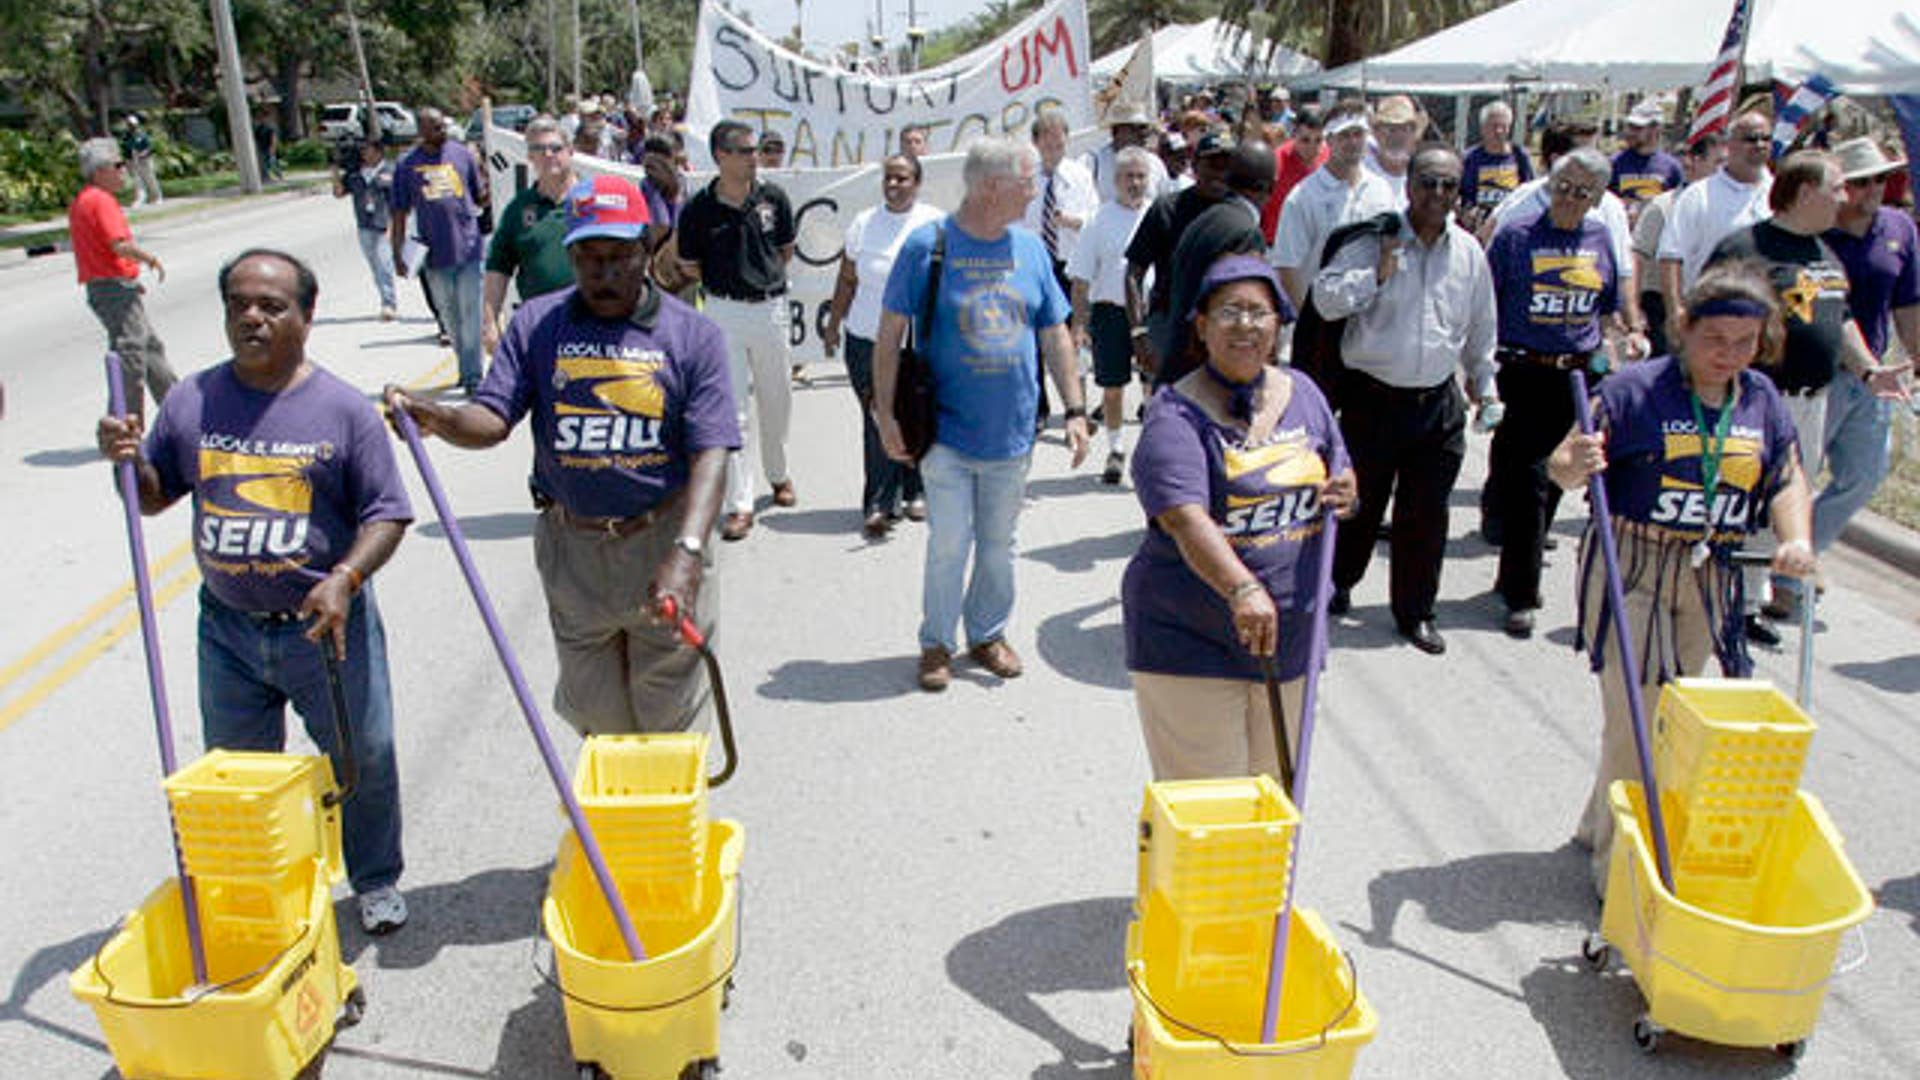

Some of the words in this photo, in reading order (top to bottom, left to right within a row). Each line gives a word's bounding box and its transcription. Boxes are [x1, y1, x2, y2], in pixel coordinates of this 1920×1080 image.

[1000, 15, 1079, 95] UM
[731, 97, 1063, 168] JANIOR
[1529, 291, 1598, 313] SEIU
[557, 342, 601, 357] LOCAL
[200, 433, 250, 453] LOCAL
[554, 416, 664, 451] SEIU
[1223, 486, 1322, 534] SEIU
[1650, 490, 1749, 525] SEIU
[200, 516, 308, 556] SEIU
